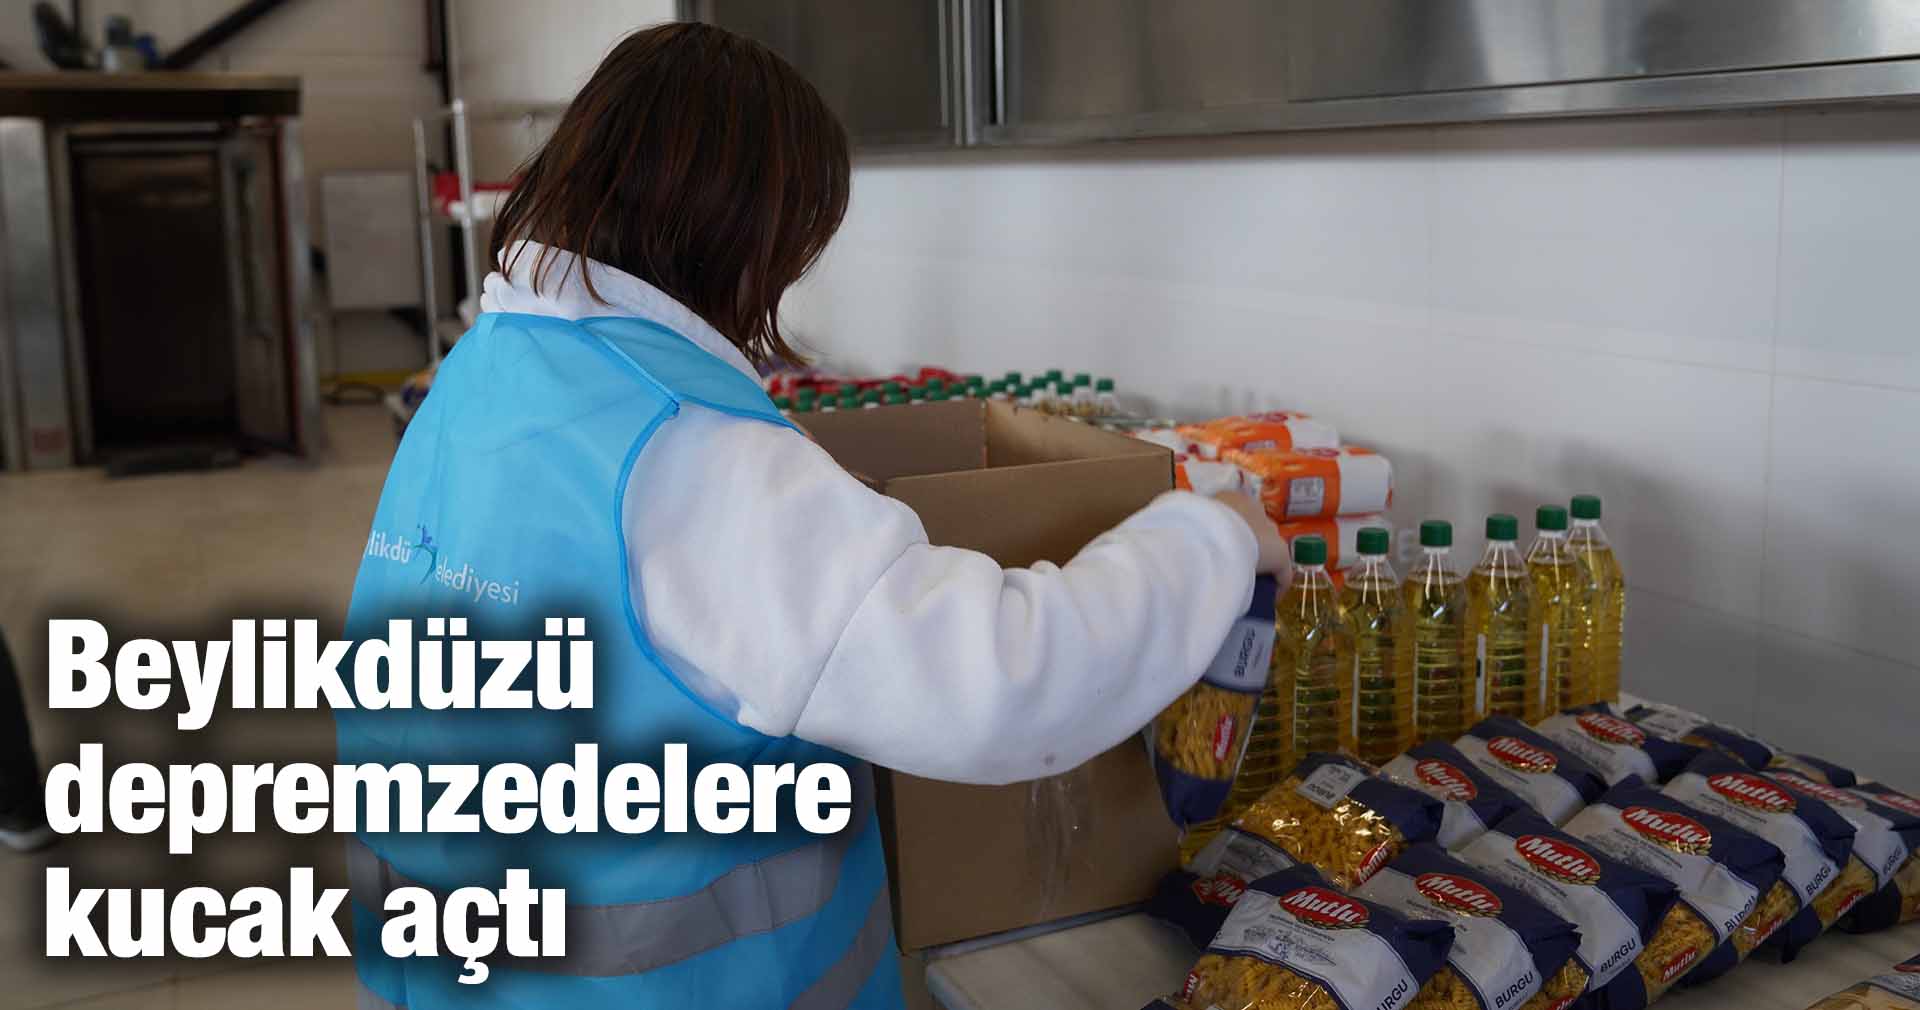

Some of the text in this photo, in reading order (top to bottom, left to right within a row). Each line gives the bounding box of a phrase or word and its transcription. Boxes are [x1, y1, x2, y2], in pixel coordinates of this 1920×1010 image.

[1711, 775, 1788, 807] Mutlu
[1626, 808, 1702, 843] Mutlu
[1519, 837, 1593, 876] Mutlu
[1284, 890, 1361, 922] Mutlu
[1418, 876, 1495, 910] Mutlu
[1600, 937, 1637, 973] BURGU
[1494, 971, 1535, 1009] BURGU
